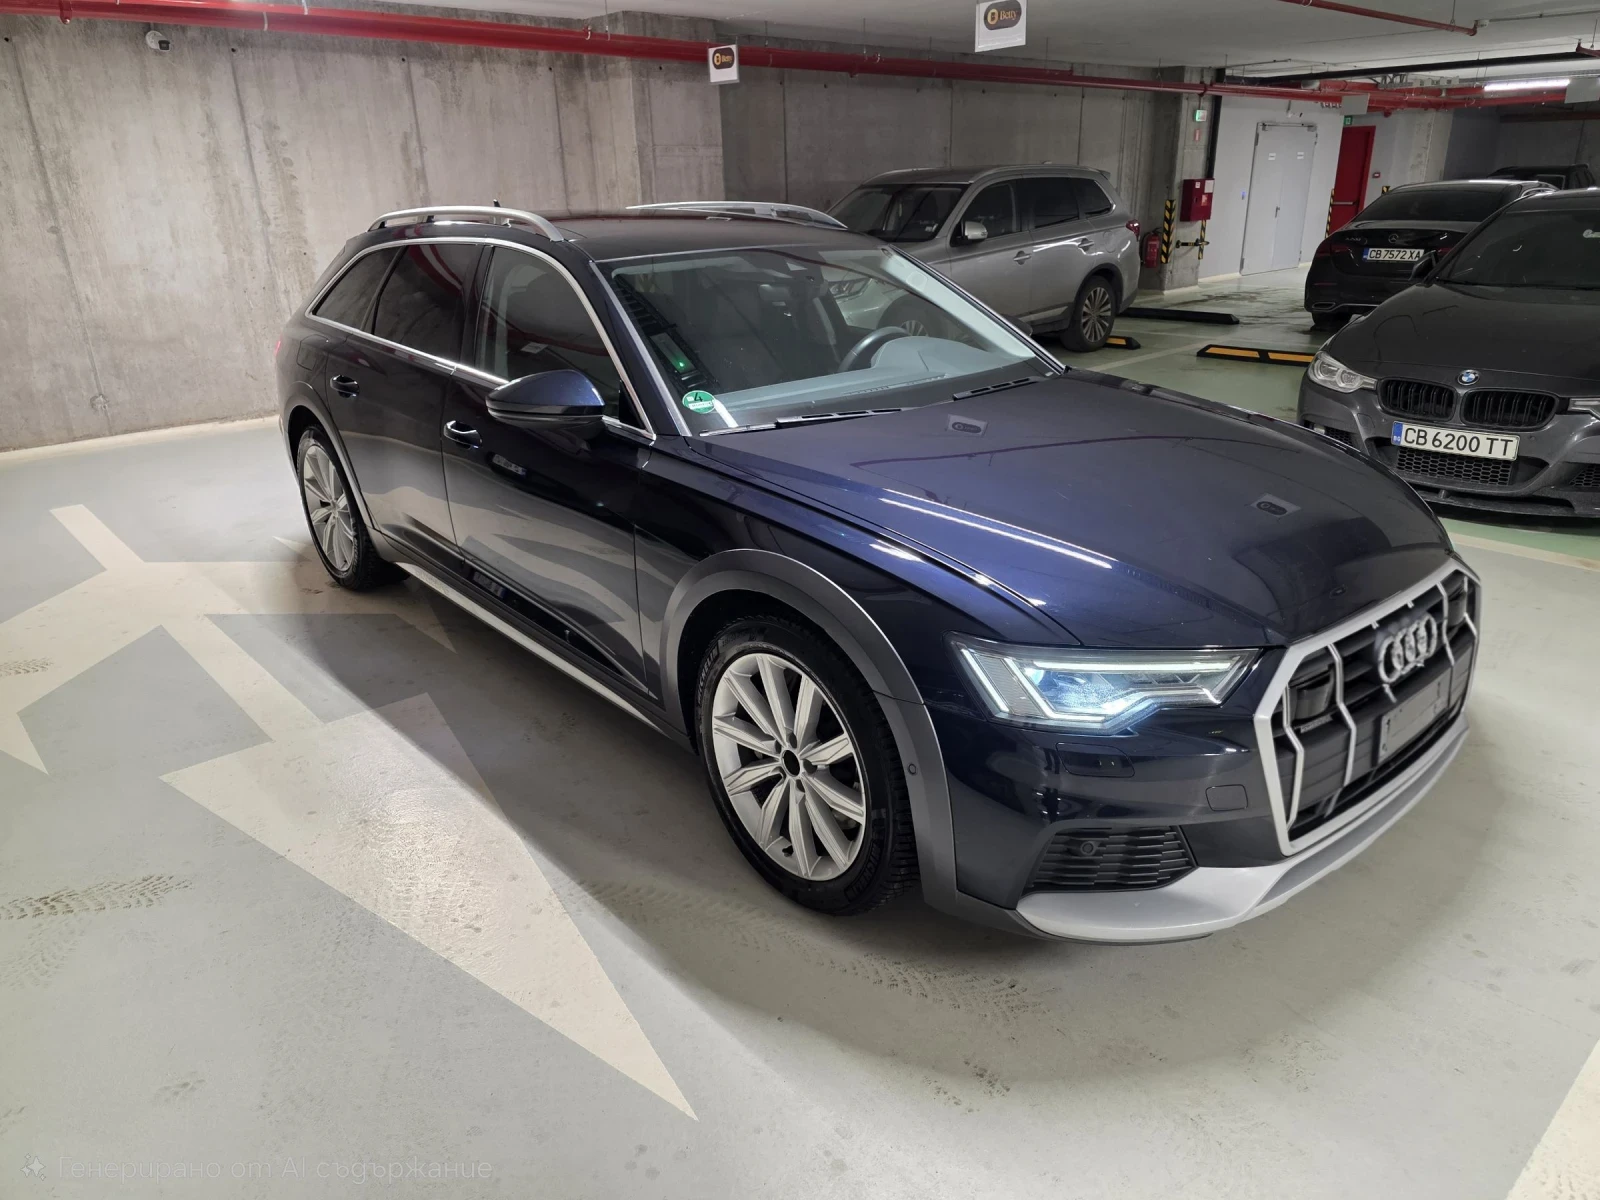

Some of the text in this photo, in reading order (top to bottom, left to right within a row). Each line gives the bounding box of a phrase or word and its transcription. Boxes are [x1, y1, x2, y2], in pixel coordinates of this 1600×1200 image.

[1369, 249, 1421, 260] CB 7572 XA
[694, 392, 703, 402] 4
[1404, 427, 1514, 456] CB 6200 TT
